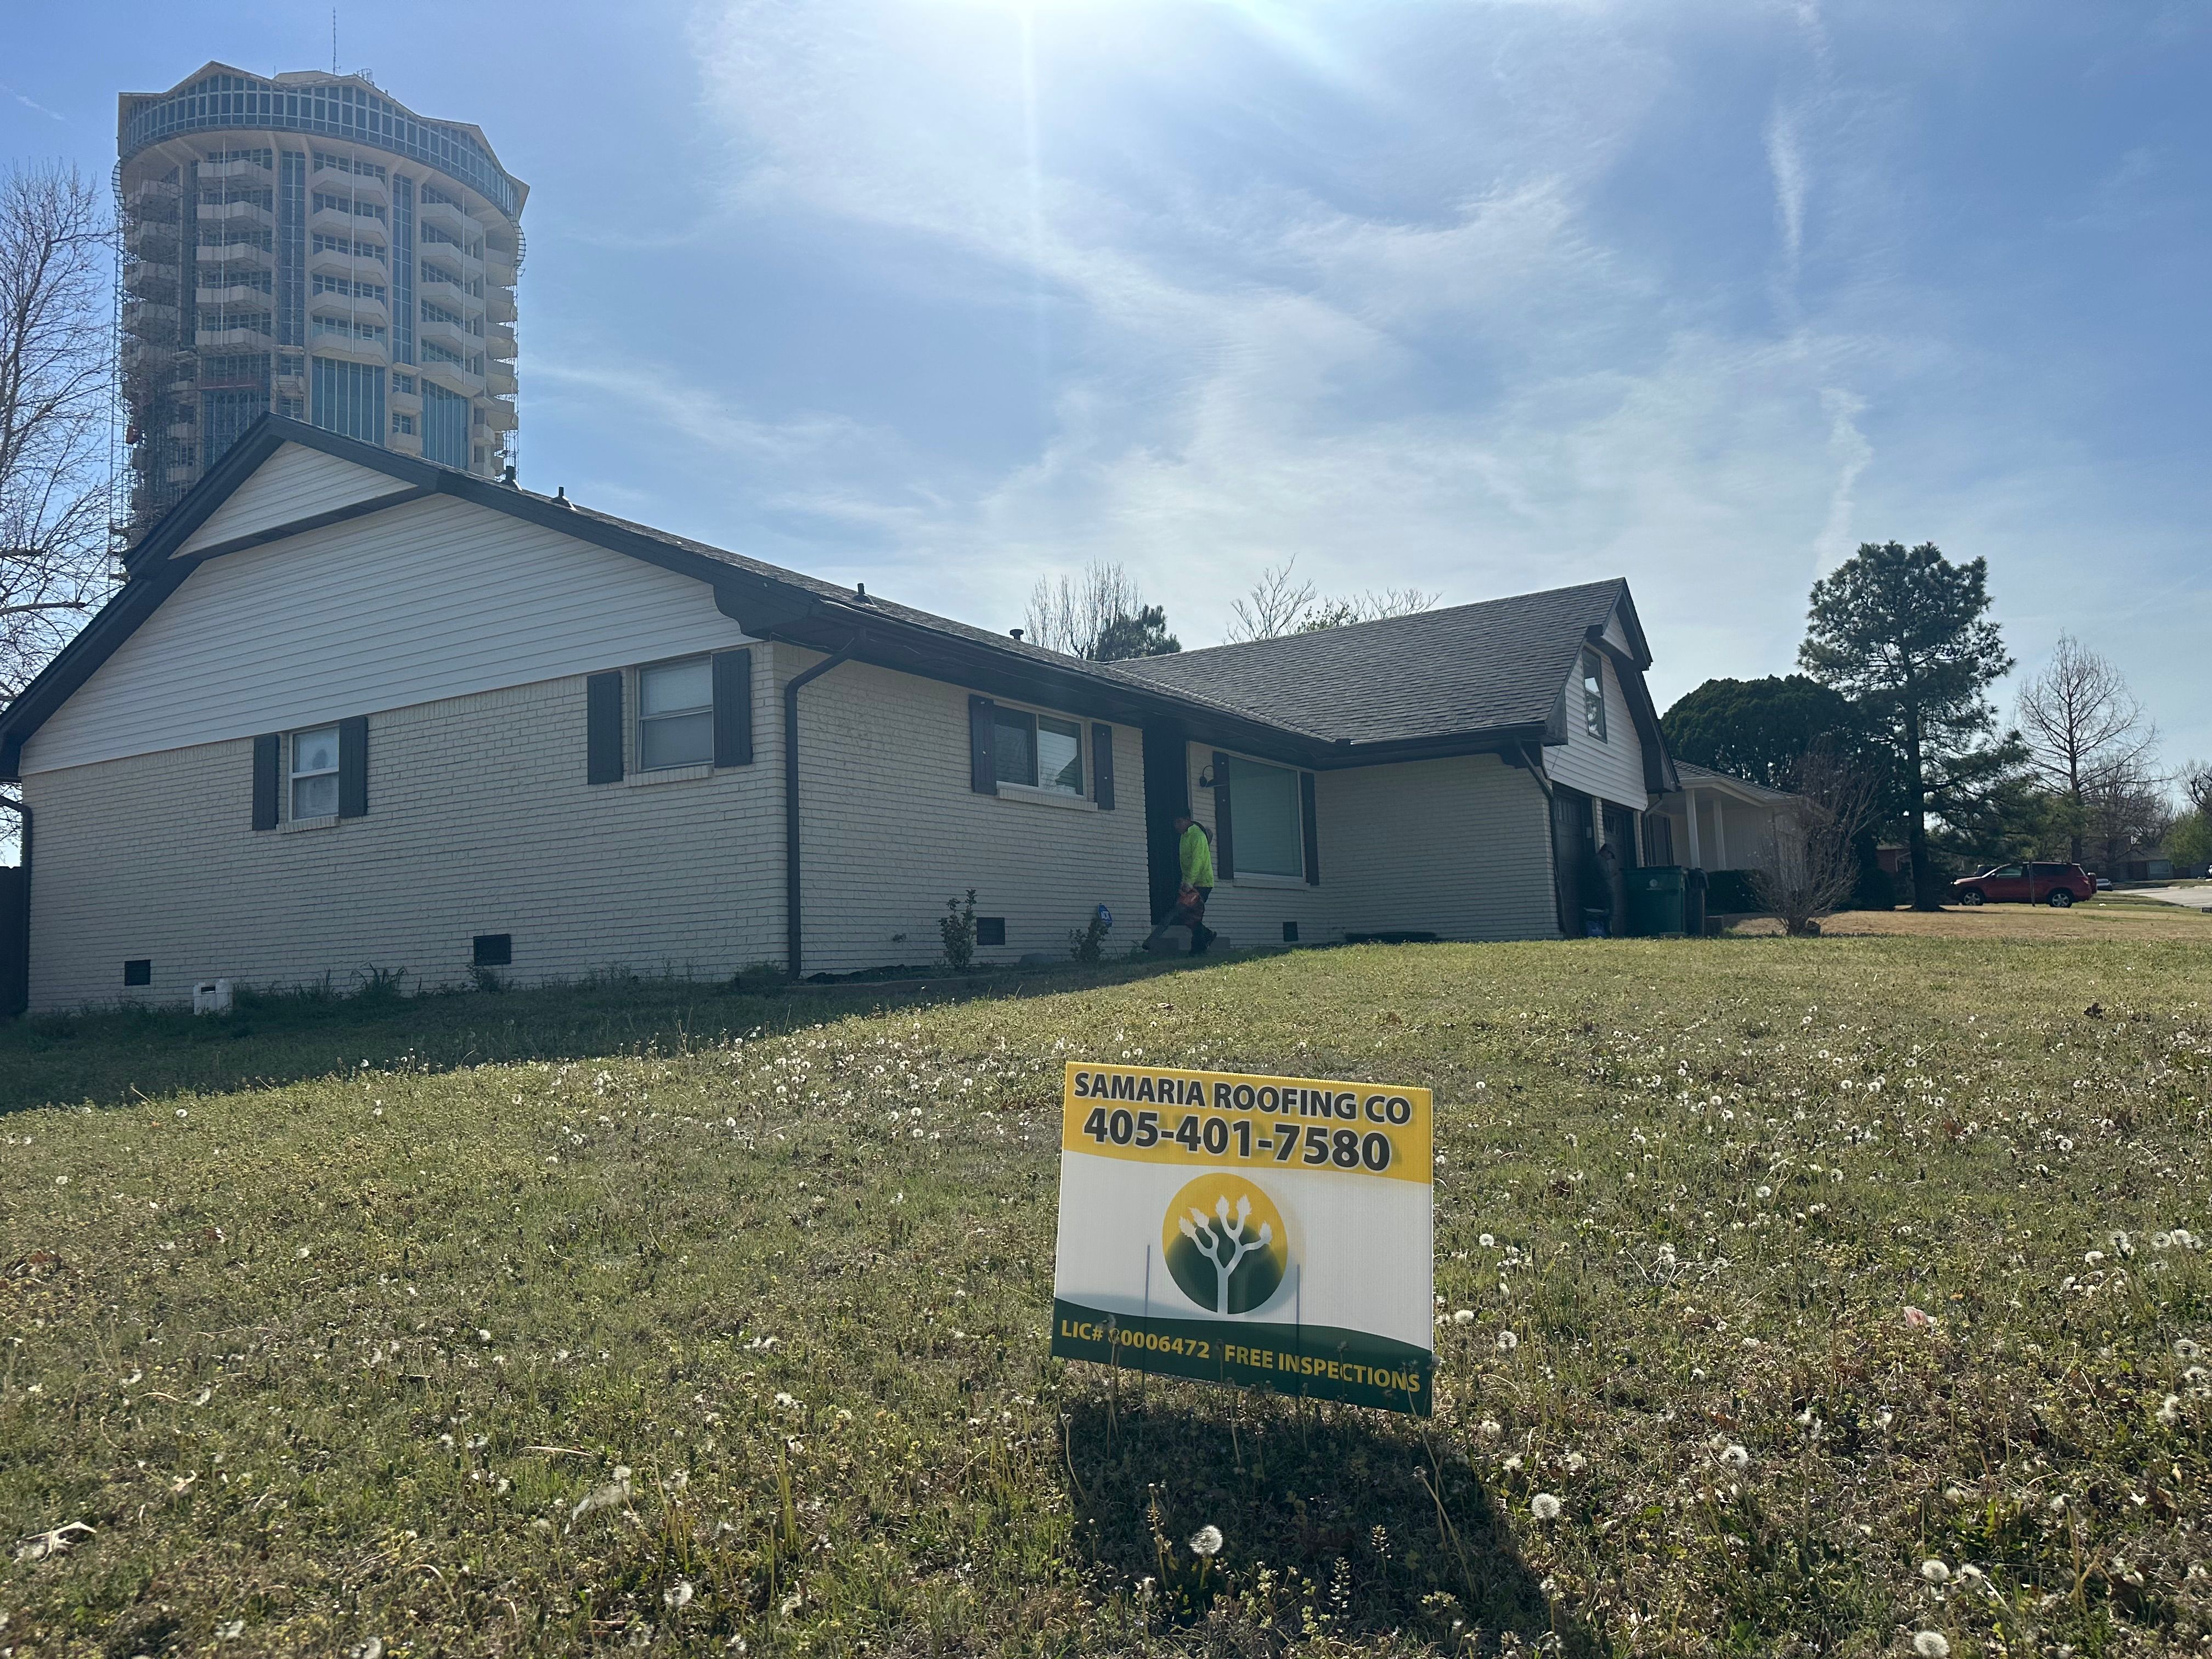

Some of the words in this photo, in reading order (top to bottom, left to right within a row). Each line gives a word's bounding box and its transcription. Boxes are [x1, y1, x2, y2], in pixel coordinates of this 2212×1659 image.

[1074, 1072, 1206, 1107] SAMARIA
[1214, 1083, 1356, 1120] ROOFING
[1365, 1095, 1411, 1125] CO
[1084, 1108, 1390, 1171] 405-401-7580
[1062, 1319, 1104, 1342] LIC#
[1224, 1344, 1273, 1369] FREE
[1279, 1352, 1421, 1392] INSPECTIONS
